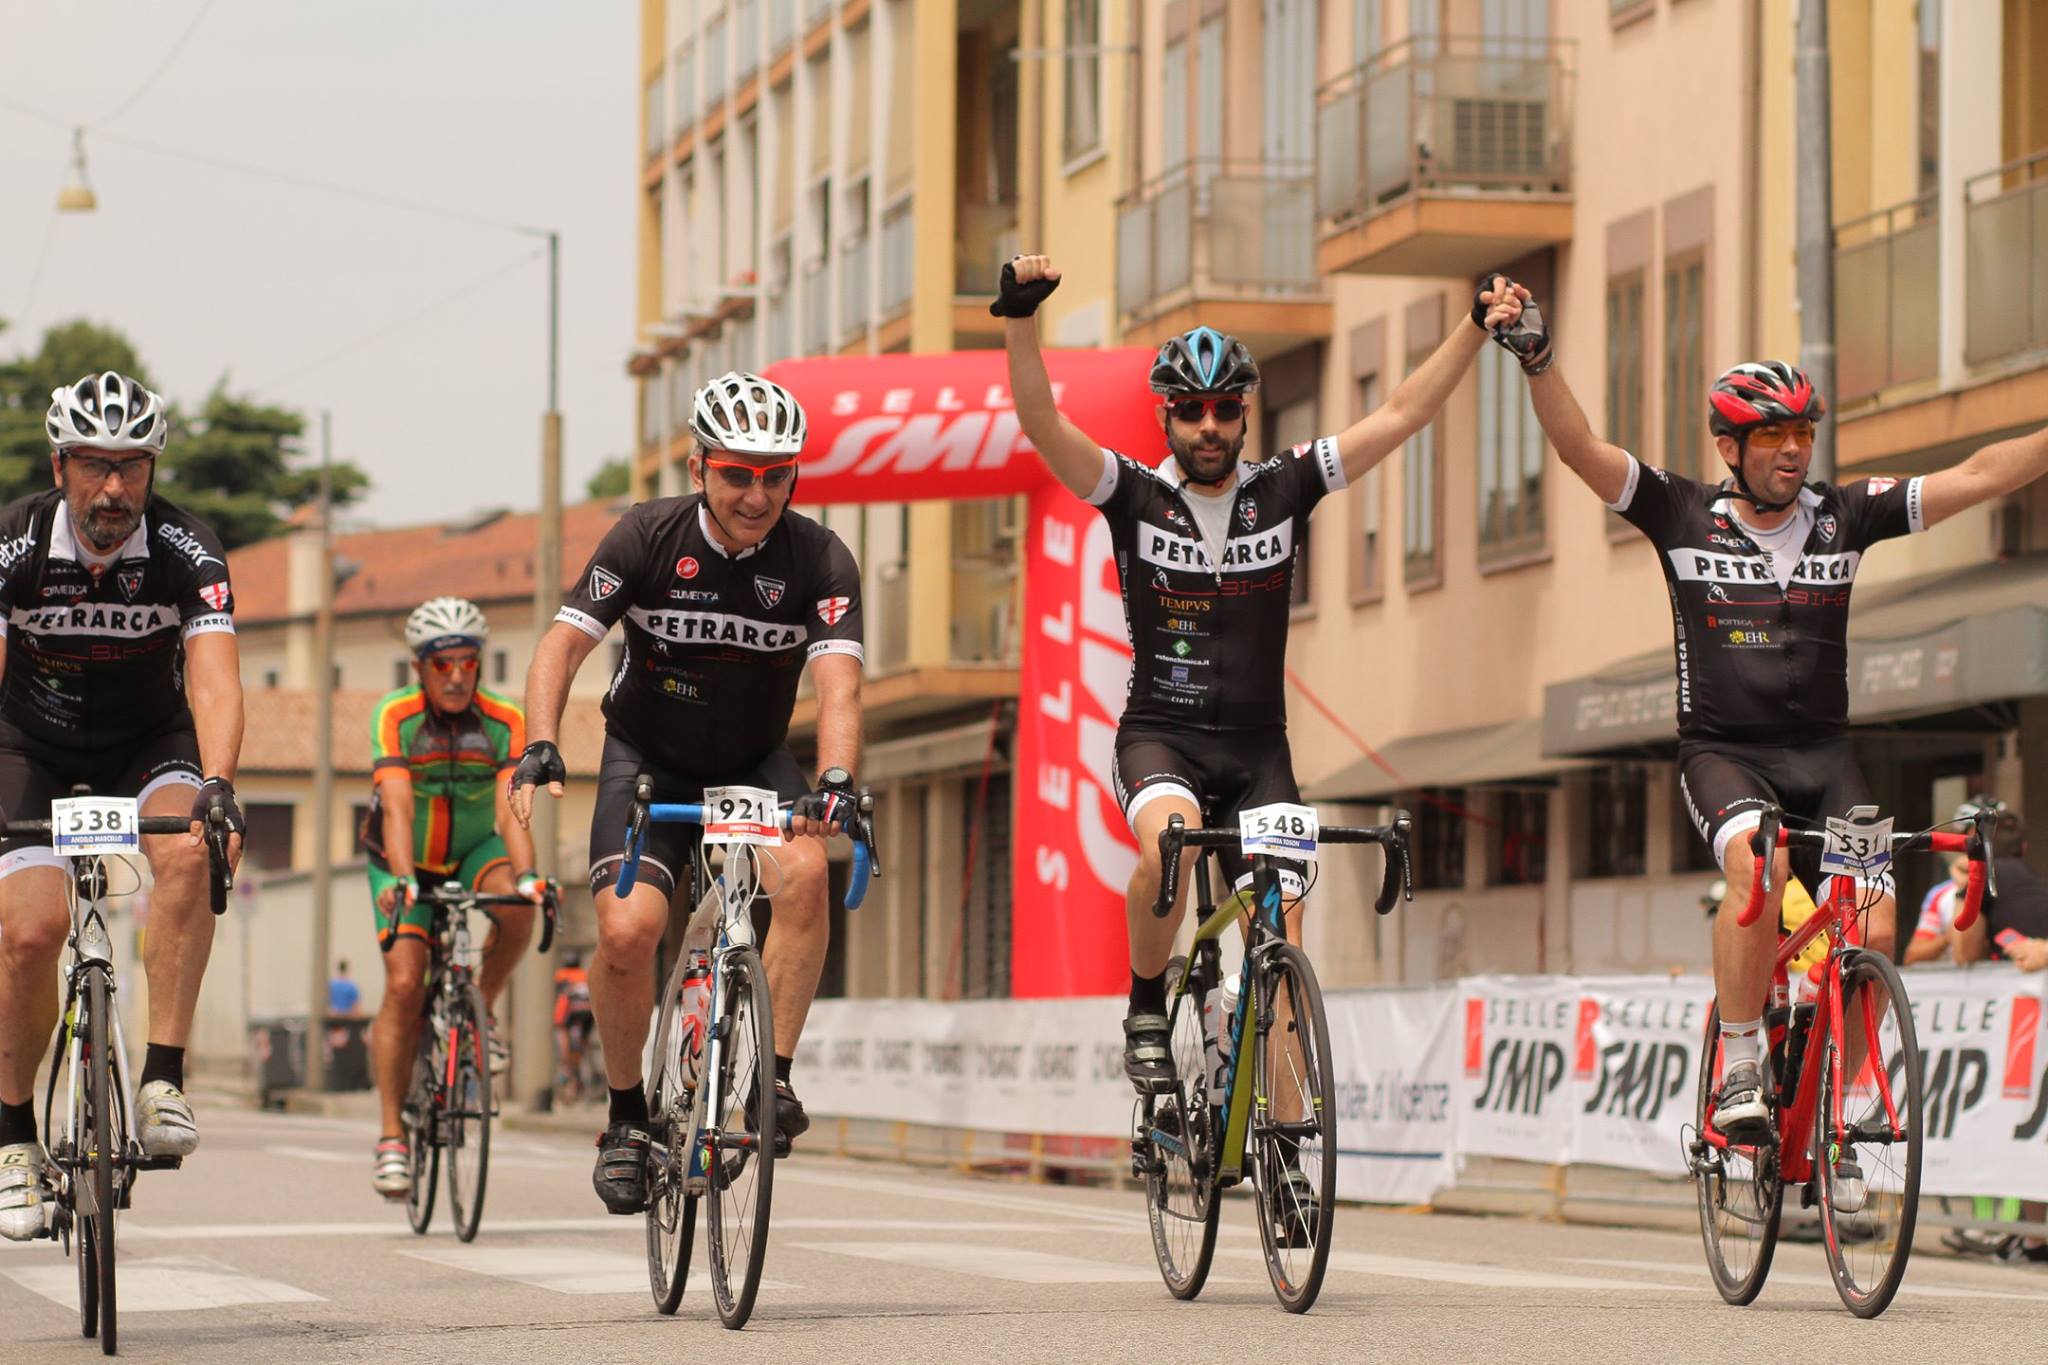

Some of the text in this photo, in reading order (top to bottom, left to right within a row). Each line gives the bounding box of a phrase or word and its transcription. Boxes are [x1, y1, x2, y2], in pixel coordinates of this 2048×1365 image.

[157, 522, 224, 567] etixx
[26, 609, 162, 631] PETRARCA
[648, 615, 797, 648] PETRARCA
[1745, 632, 1770, 644] EHR
[1679, 642, 1691, 712] PETRARCA
[1036, 515, 1075, 892] SELLE
[70, 810, 122, 832] 538
[720, 799, 764, 822] 921
[1257, 815, 1305, 836] 548
[1840, 834, 1879, 857] 531
[1489, 999, 1569, 1029] SELLE
[1604, 1000, 1695, 1030] SELLE
[1475, 1039, 1564, 1115] SMP
[1585, 1042, 1688, 1121] SMP
